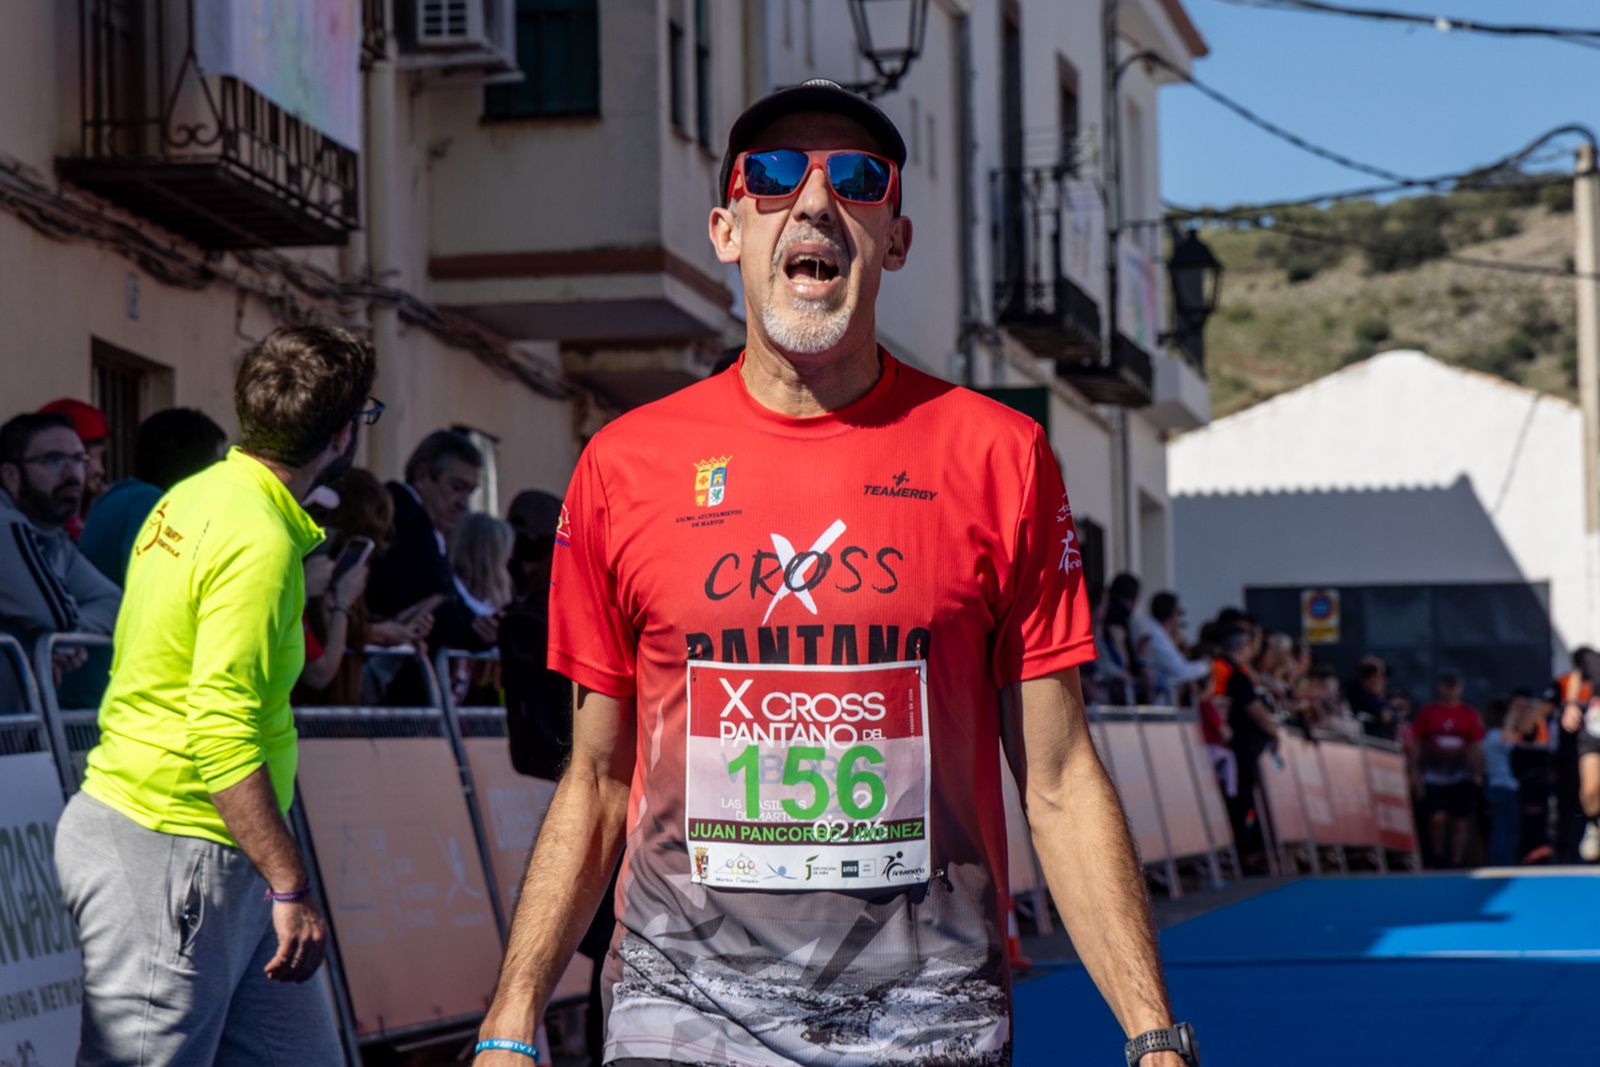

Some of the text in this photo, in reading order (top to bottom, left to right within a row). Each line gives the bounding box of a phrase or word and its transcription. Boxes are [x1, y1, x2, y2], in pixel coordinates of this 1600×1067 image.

[863, 484, 938, 502] TEAMERGY
[704, 546, 904, 601] CROSS
[719, 678, 754, 719] X
[762, 691, 886, 722] CROSS
[720, 722, 886, 749] PANTANO DEL
[728, 745, 887, 821] 156
[721, 798, 741, 809] LAS
[691, 822, 923, 843] JUAN PANCORBO JIMENEZ
